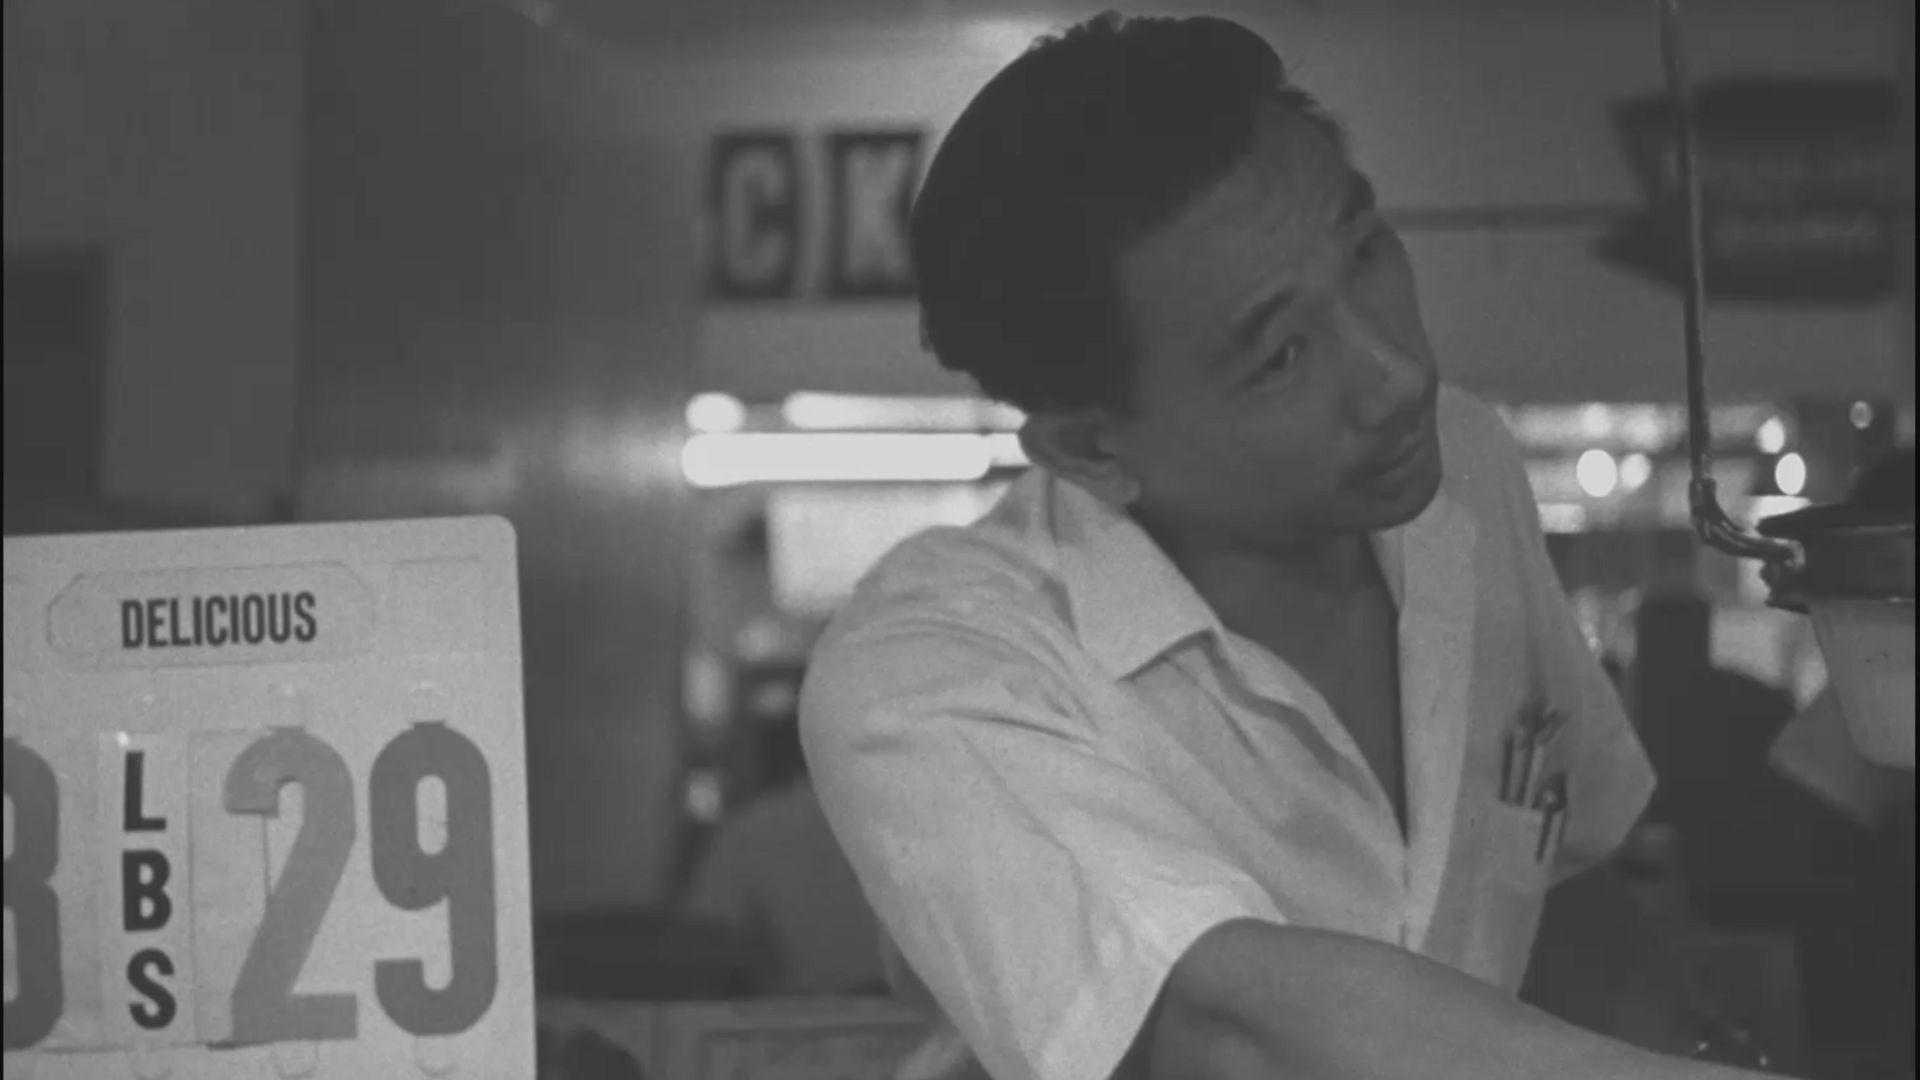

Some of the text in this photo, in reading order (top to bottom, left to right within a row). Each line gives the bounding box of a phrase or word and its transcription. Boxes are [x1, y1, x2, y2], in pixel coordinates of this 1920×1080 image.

[121, 591, 317, 649] DELICIOUS
[122, 750, 177, 1030] LBS
[223, 720, 499, 1043] 29
